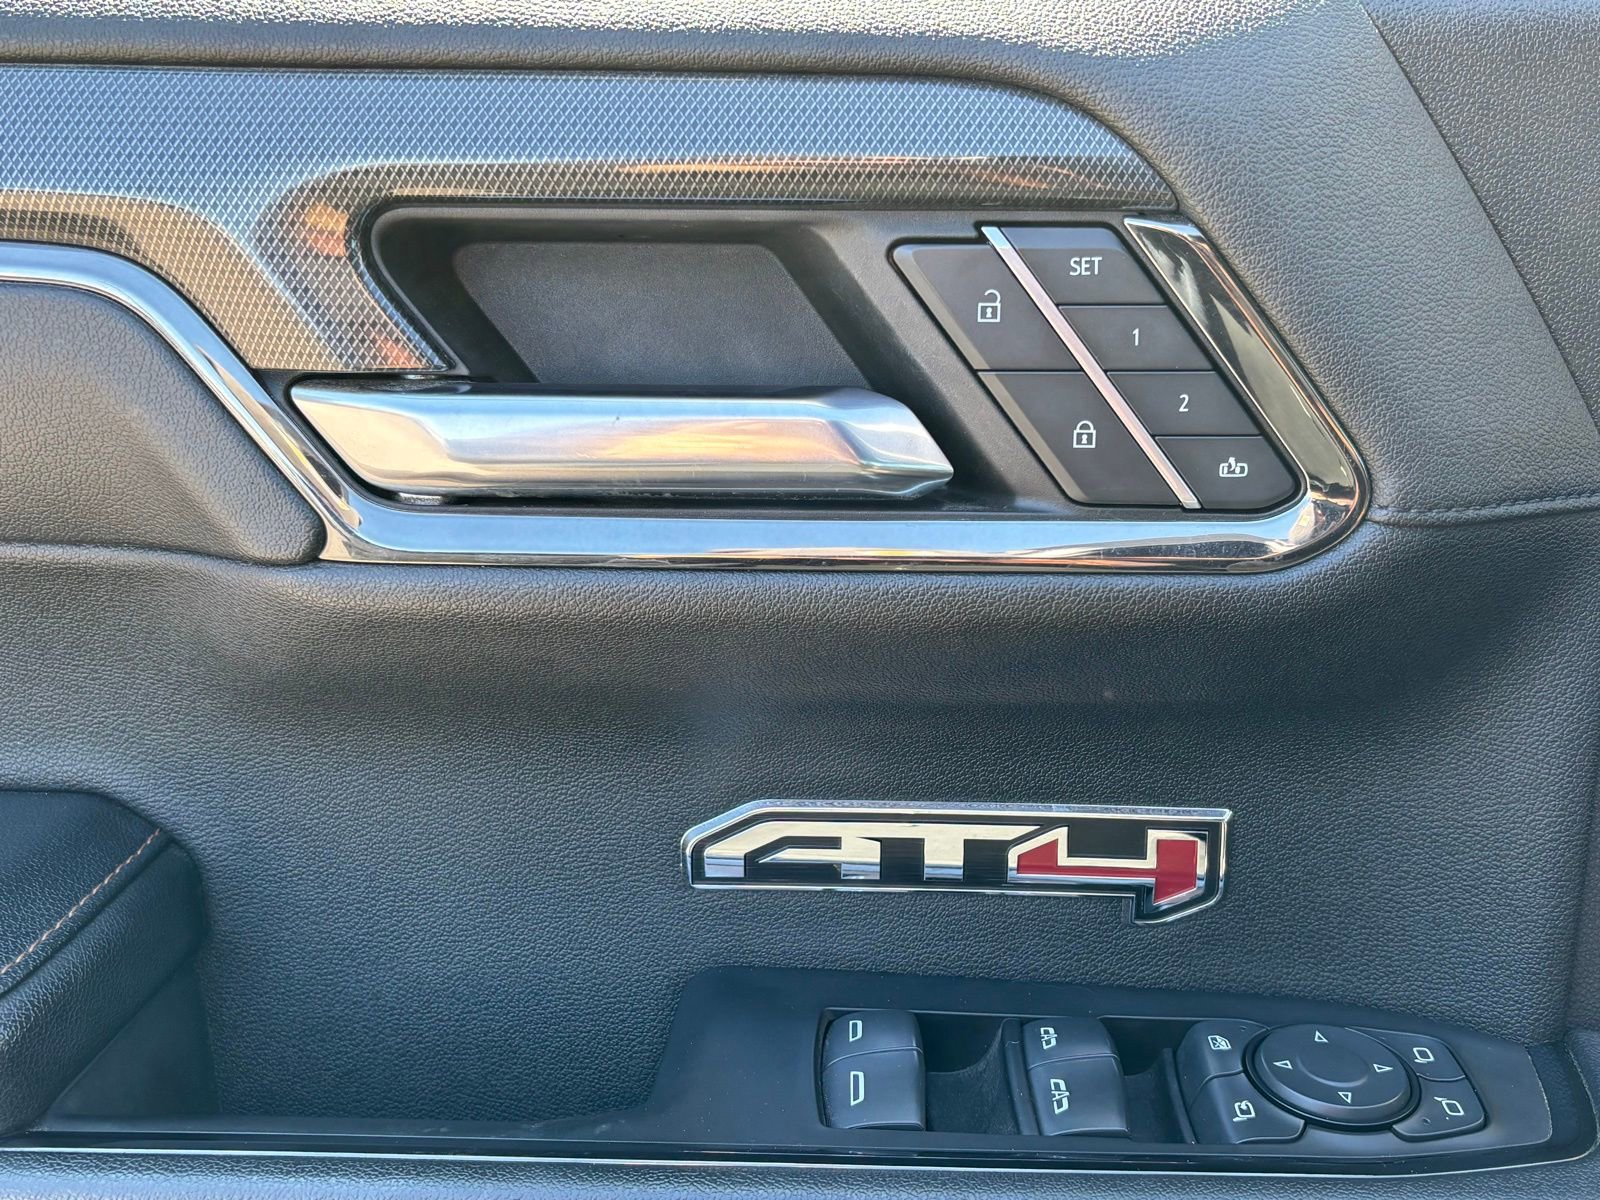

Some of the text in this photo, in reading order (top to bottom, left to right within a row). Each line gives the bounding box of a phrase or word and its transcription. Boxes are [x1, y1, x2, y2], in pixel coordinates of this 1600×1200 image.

[1069, 256, 1103, 276] SET
[1131, 328, 1140, 346] 1
[1178, 394, 1189, 412] 2
[704, 820, 1209, 907] AT4
